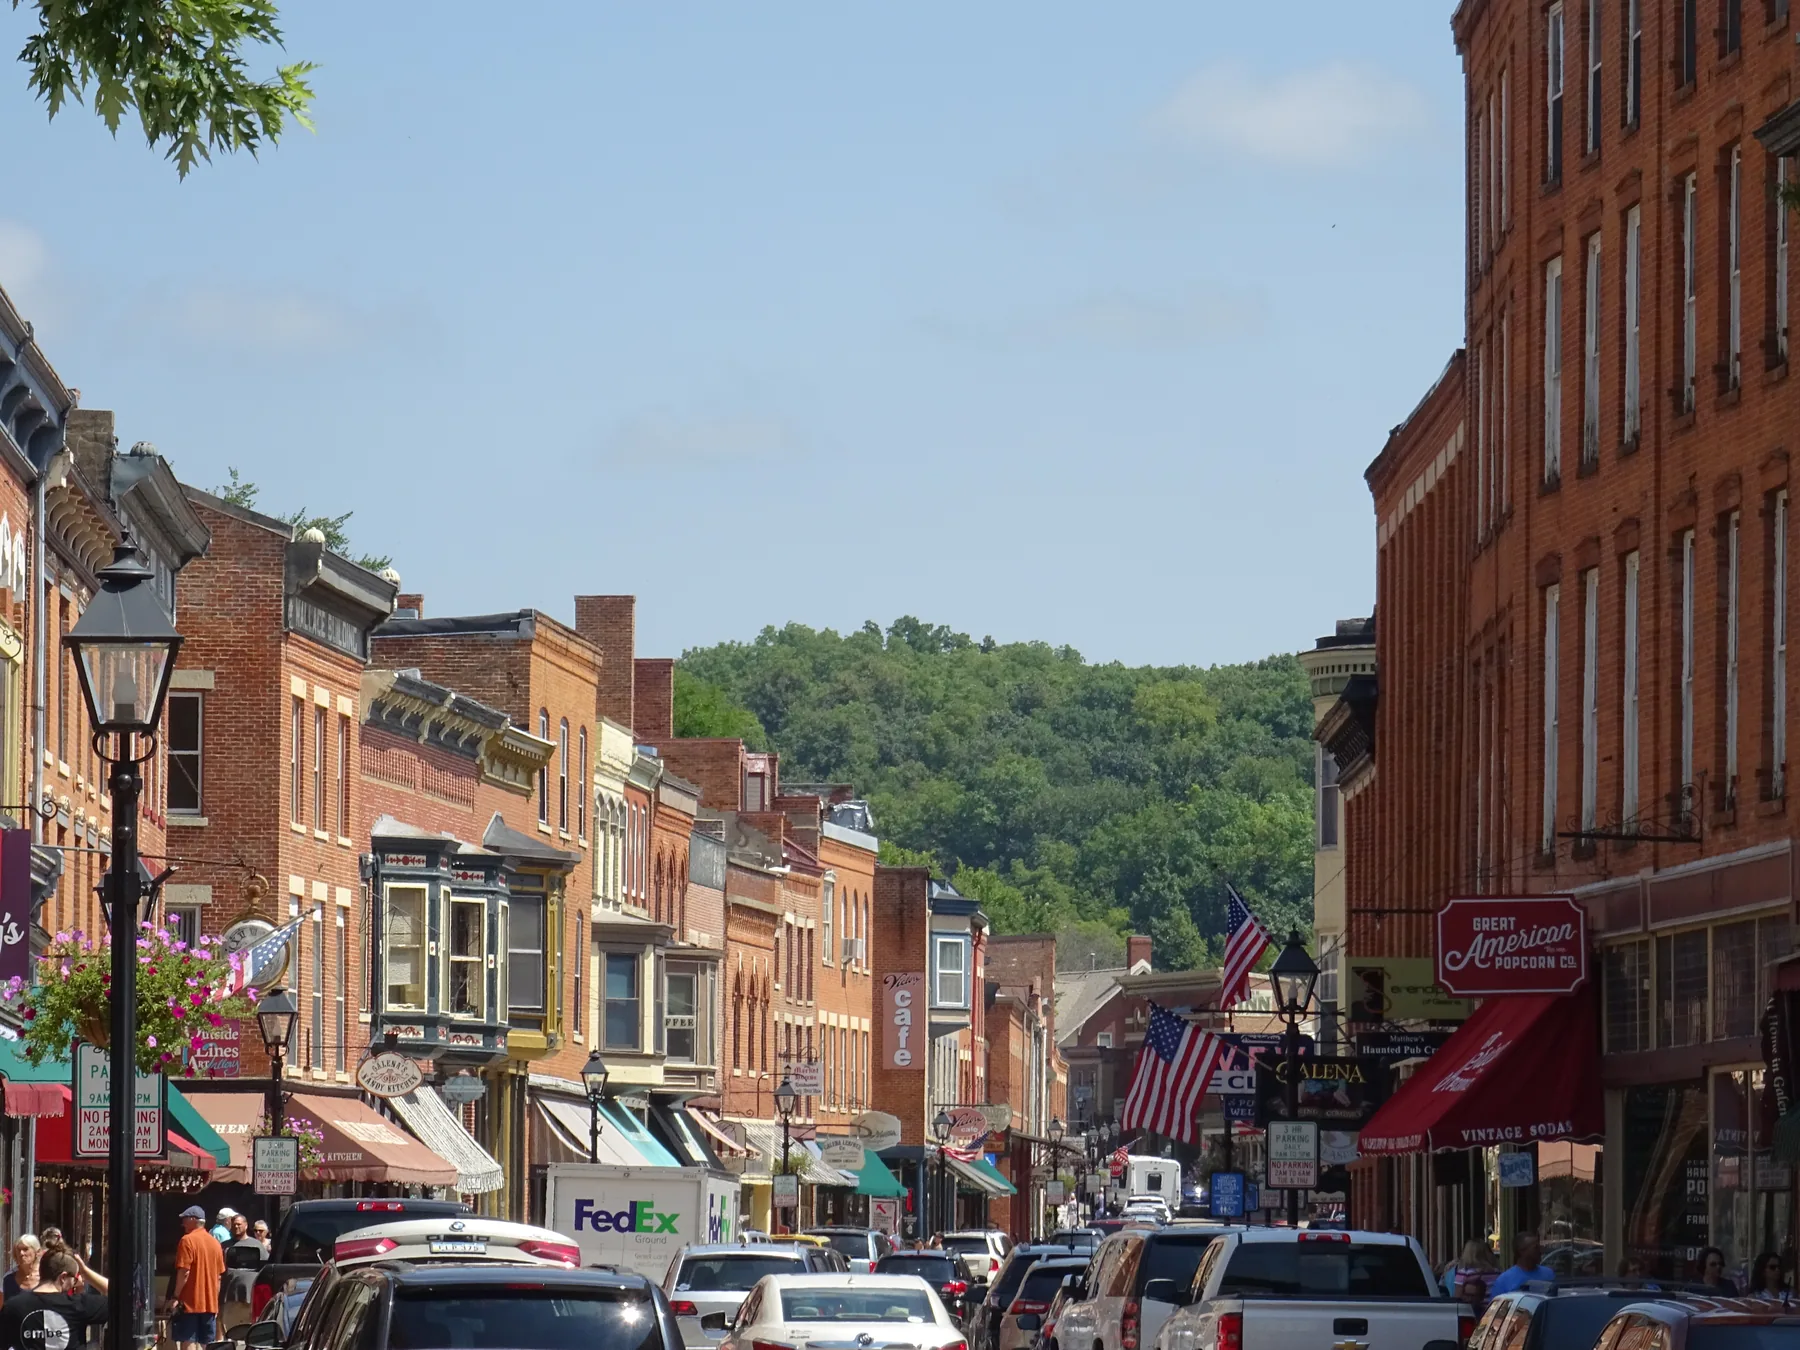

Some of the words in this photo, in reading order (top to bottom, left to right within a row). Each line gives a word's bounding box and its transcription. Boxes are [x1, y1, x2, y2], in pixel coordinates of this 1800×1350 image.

[1473, 917, 1515, 931] GREAT
[1445, 923, 1577, 971] American
[1495, 956, 1555, 969] POPCORN
[1363, 1046, 1400, 1054] Haunted
[1404, 1046, 1421, 1054] Pub
[372, 1060, 408, 1073] GALENA'S
[387, 1075, 419, 1092] KITCHEN
[1774, 1076, 1787, 1116] Galen
[83, 1111, 100, 1123] NO
[1284, 1125, 1288, 1133] 3
[1461, 1128, 1522, 1142] VINTAGE
[1530, 1121, 1573, 1135] SODAS
[88, 1139, 109, 1149] MON
[135, 1139, 151, 1149] FRI
[1276, 1135, 1309, 1143] PARKING
[327, 1152, 363, 1161] KITCHEN
[574, 1198, 680, 1233] FedEx
[635, 1235, 667, 1244] Ground
